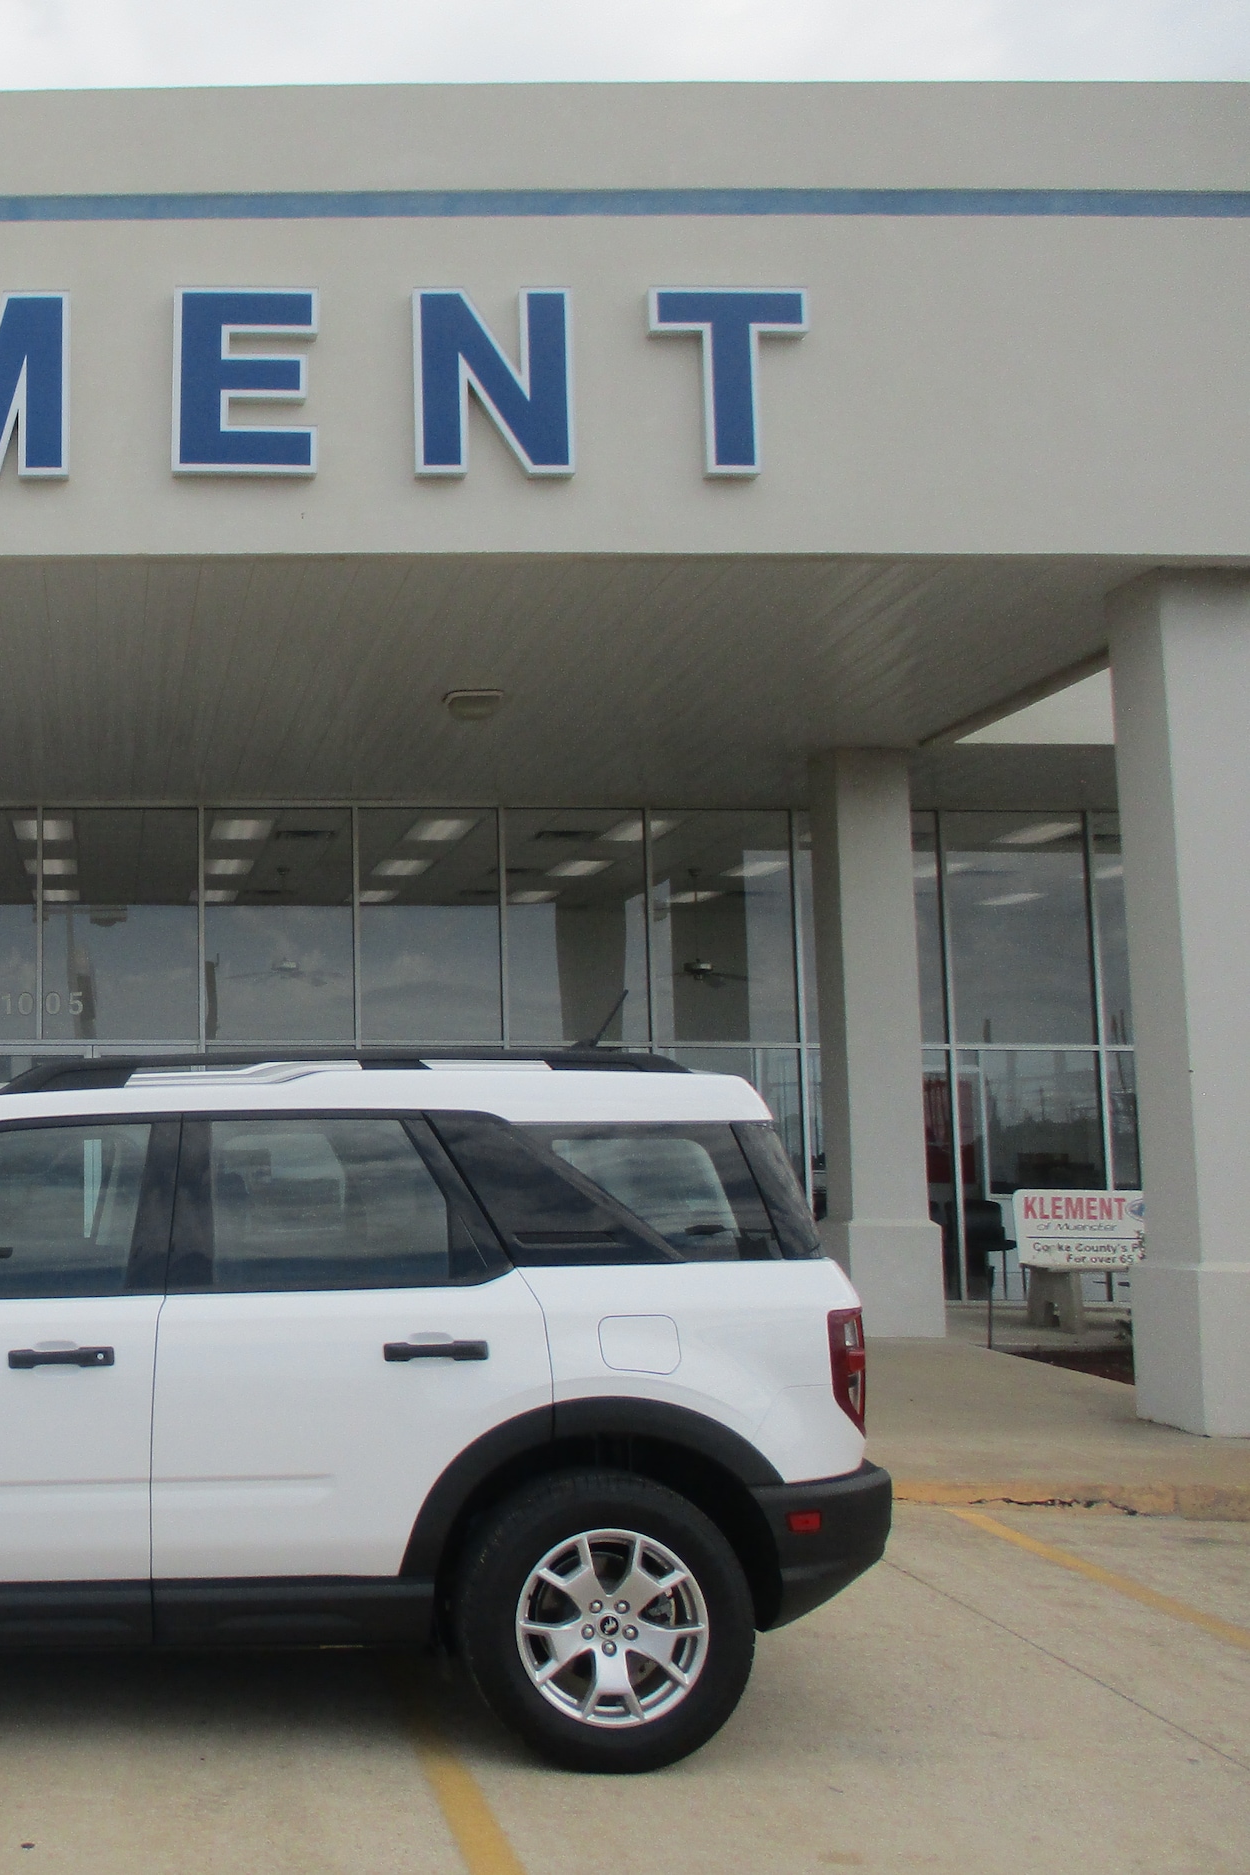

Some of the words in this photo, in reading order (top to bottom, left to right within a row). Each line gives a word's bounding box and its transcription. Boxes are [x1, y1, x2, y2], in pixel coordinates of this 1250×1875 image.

[1, 992, 84, 1015] 1005
[1023, 1196, 1126, 1220] KLEMENT
[1036, 1222, 1051, 1231] of
[1054, 1222, 1117, 1232] Muenster
[1033, 1242, 1070, 1252] Coke
[1075, 1243, 1127, 1254] County's
[1066, 1253, 1087, 1264] For
[1089, 1256, 1117, 1264] over
[1119, 1255, 1134, 1264] 65
